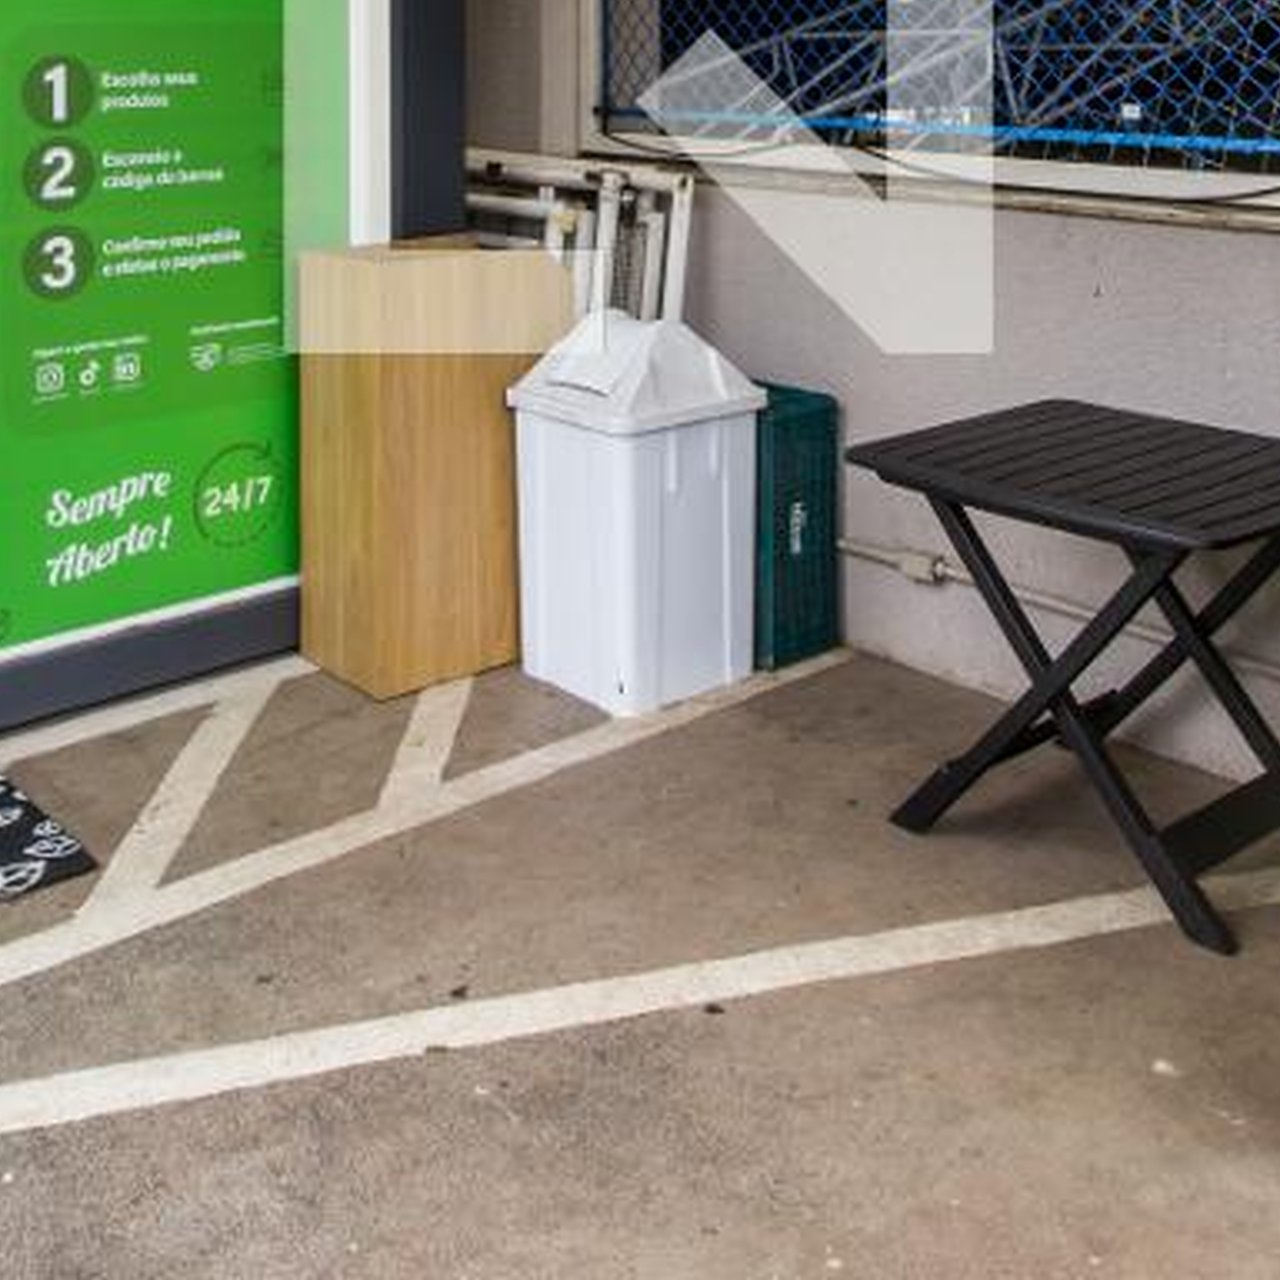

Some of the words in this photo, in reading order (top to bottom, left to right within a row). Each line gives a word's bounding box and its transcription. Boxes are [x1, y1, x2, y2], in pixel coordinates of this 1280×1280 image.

[43, 63, 67, 122] 1
[41, 146, 75, 200] 2
[41, 235, 75, 288] 3
[46, 470, 172, 529] Sempre
[202, 474, 274, 518] 24/7
[46, 515, 172, 587] Aberto!
